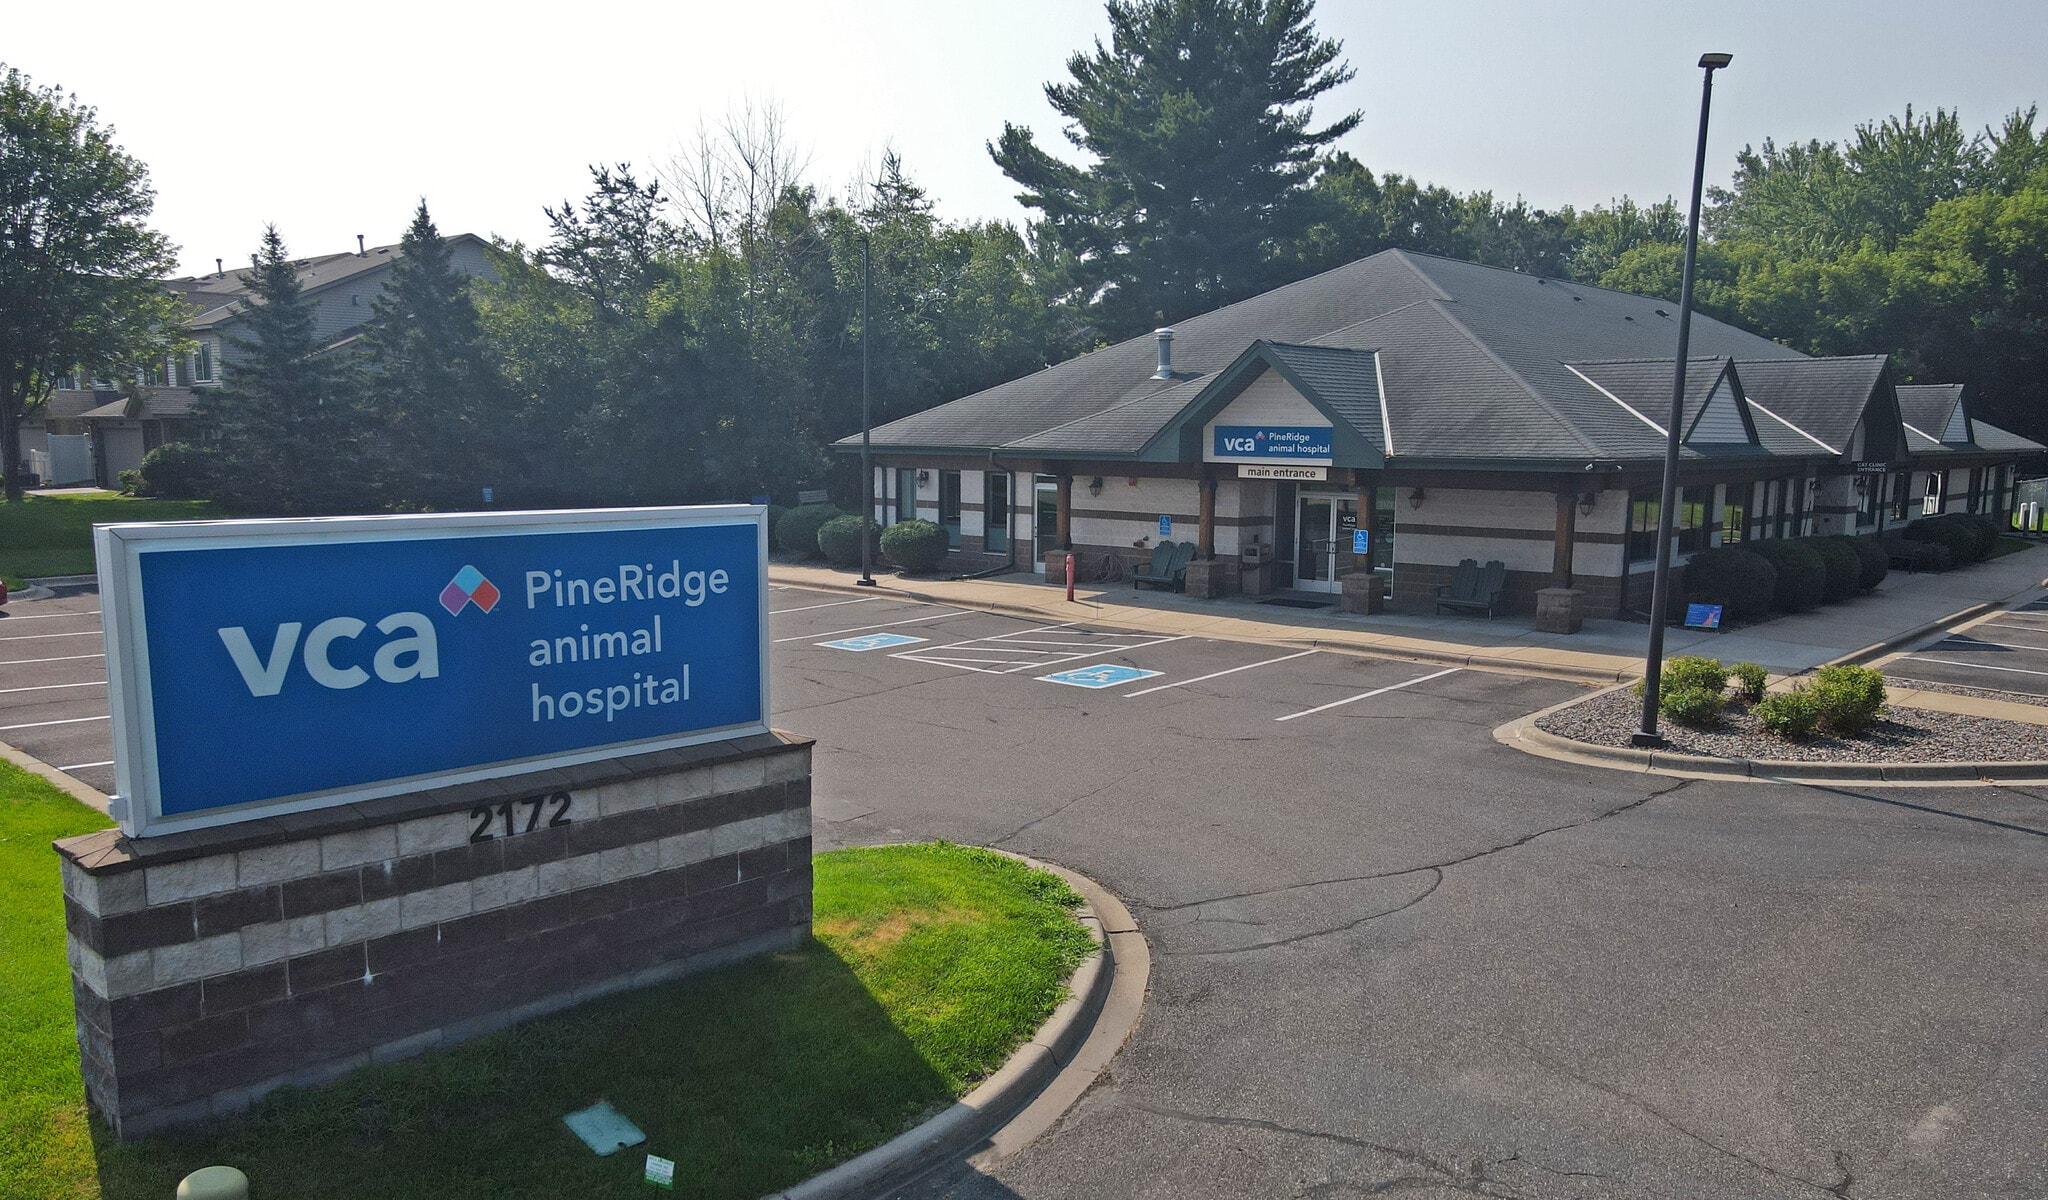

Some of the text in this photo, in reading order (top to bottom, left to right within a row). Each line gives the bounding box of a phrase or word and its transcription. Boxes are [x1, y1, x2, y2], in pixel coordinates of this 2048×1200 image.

[1223, 437, 1255, 452] vca
[1268, 444, 1330, 455] animal hospital
[1269, 432, 1310, 443] PineRidge
[1247, 467, 1316, 478] main entrance
[525, 559, 729, 610] PineRidge
[217, 611, 439, 697] vca
[529, 615, 662, 667] animal
[532, 664, 690, 722] hospital
[470, 792, 571, 844] 2172
